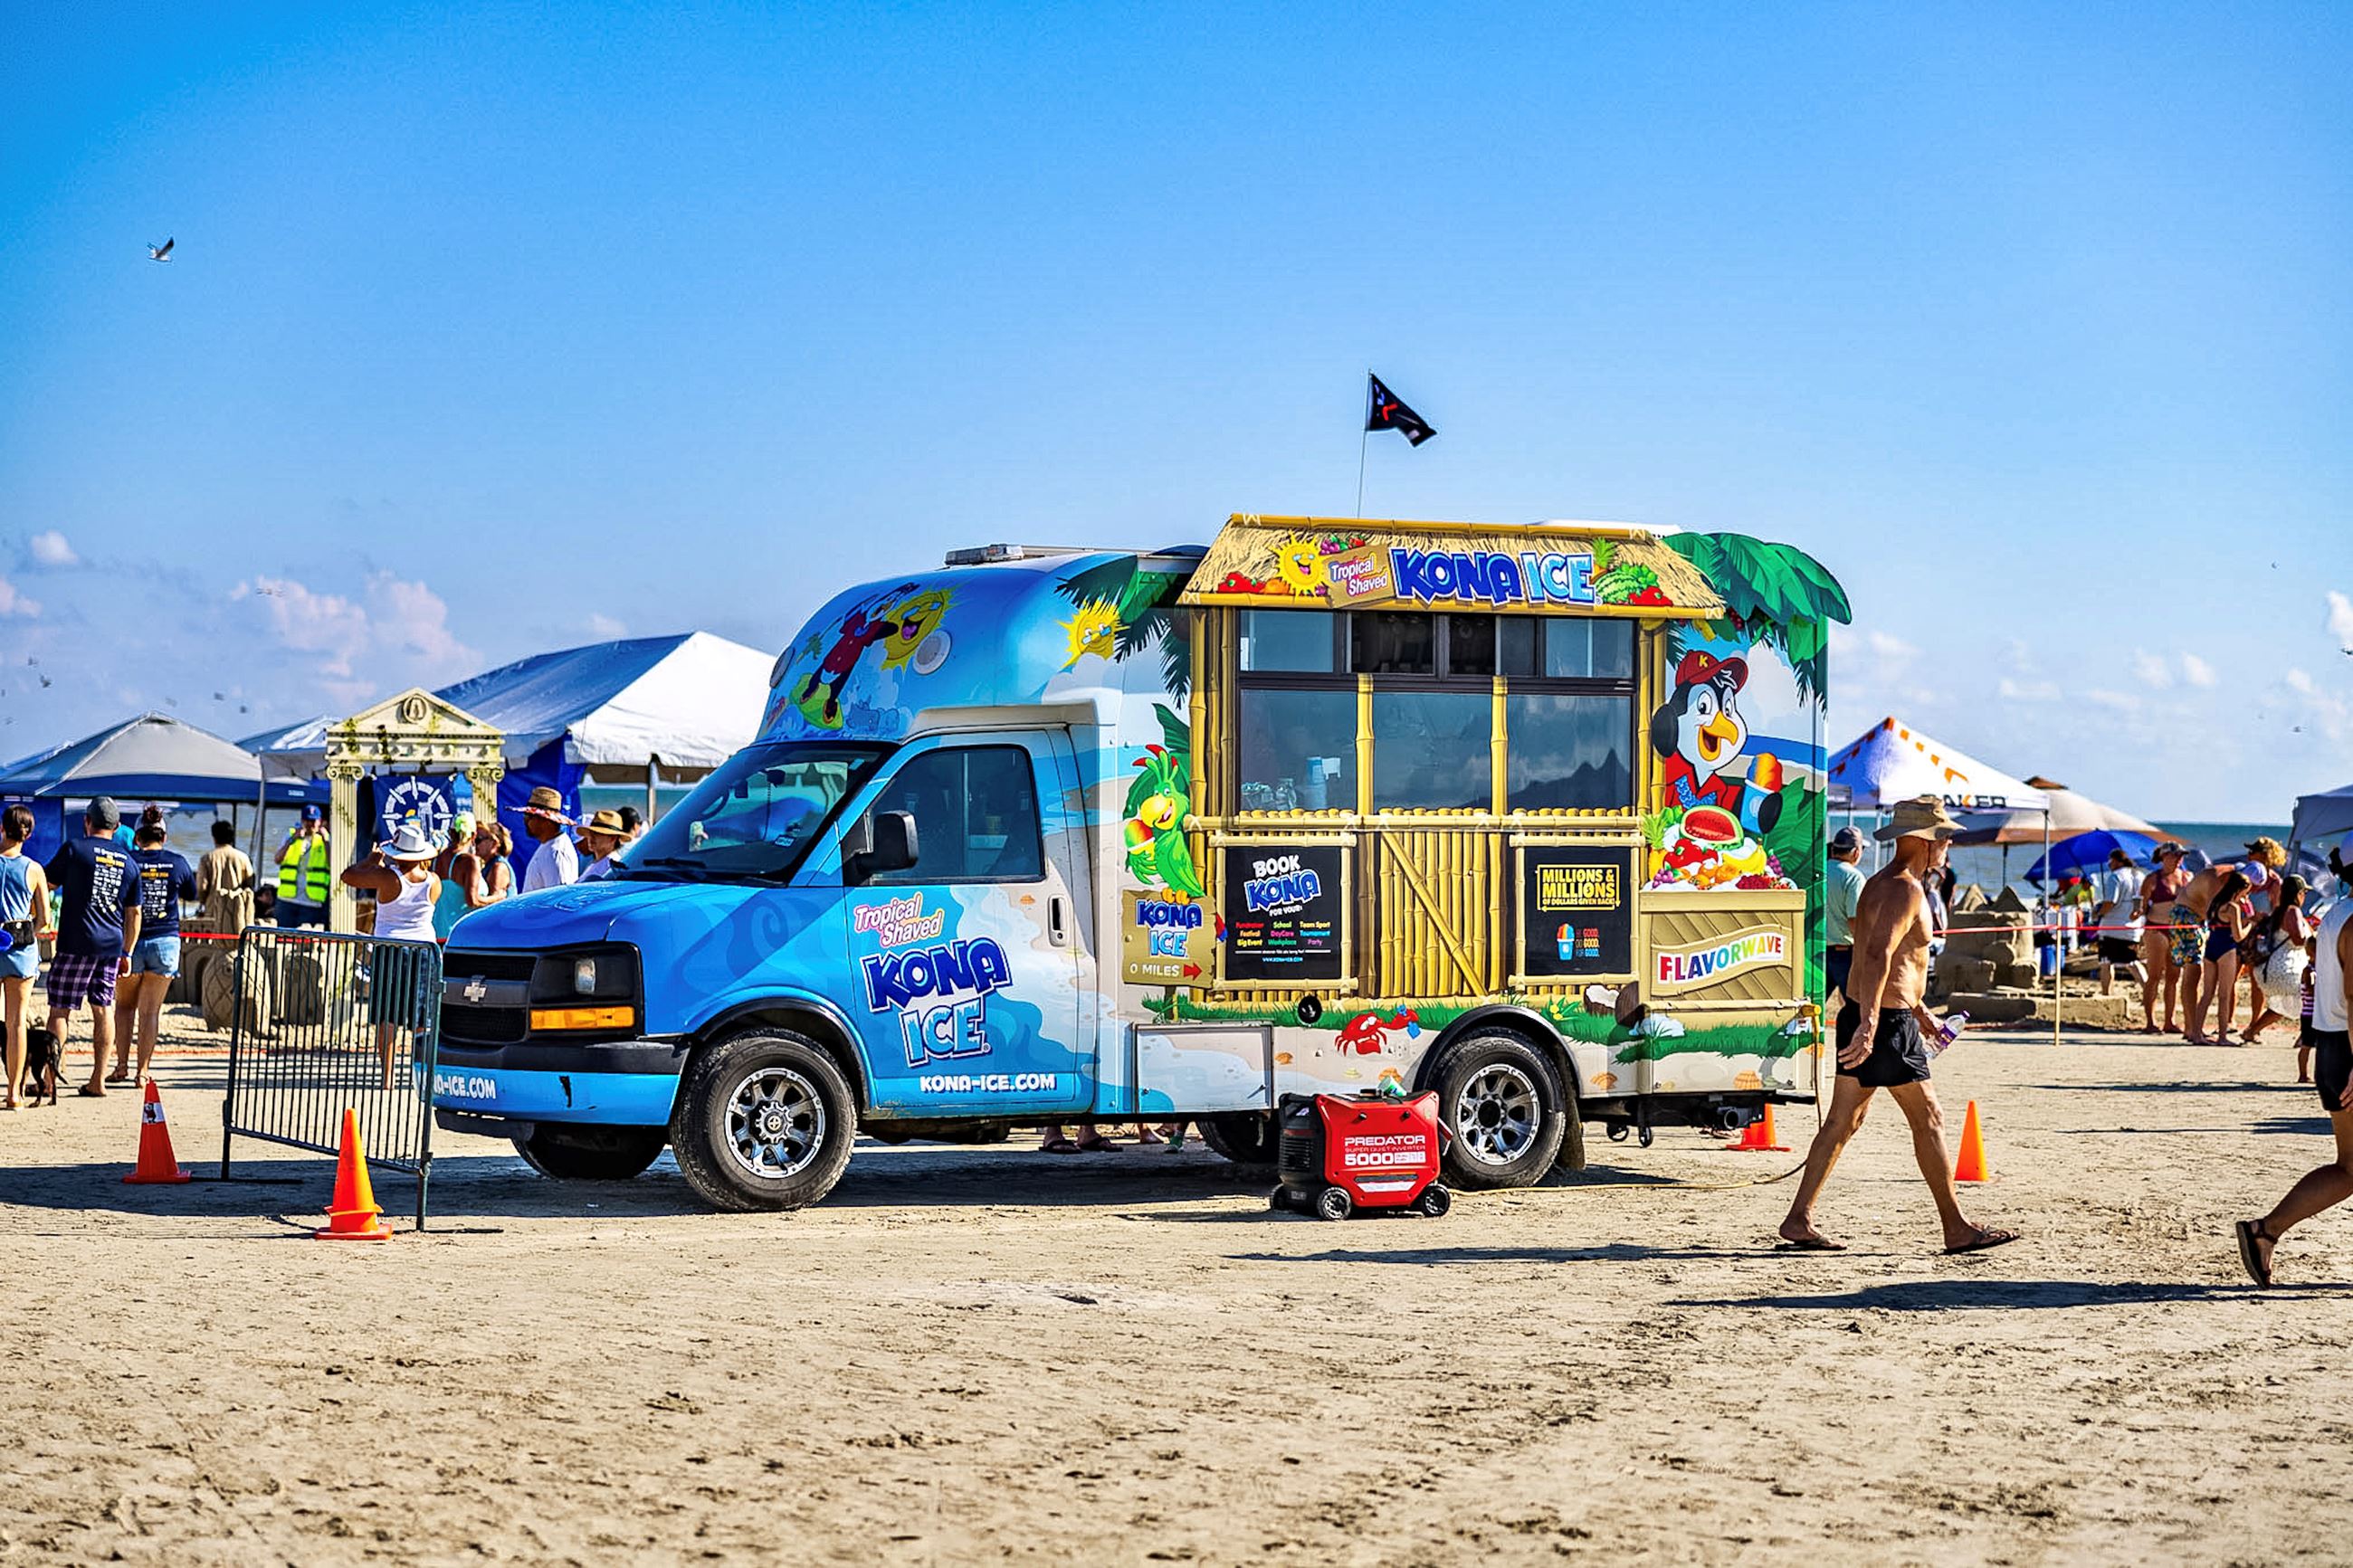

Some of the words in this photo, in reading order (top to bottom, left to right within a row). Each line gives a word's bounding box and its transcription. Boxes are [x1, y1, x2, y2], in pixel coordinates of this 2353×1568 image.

[1331, 555, 1375, 581] Tropical
[1391, 549, 1523, 605] KONA
[1521, 553, 1596, 604] ICE
[1348, 572, 1388, 595] Shaved
[1699, 654, 1708, 668] K
[1253, 854, 1300, 878] BOOK
[1542, 869, 1604, 882] MILLIONS
[1605, 869, 1615, 882] &
[1244, 870, 1321, 912] KONA
[1542, 882, 1615, 898] MILLIONS
[856, 893, 920, 931] Tropical
[1137, 900, 1202, 929] KONA
[1269, 908, 1282, 917] FOR
[881, 912, 942, 946] Shaved
[1150, 930, 1188, 957] ICE
[1237, 939, 1247, 947] Big
[1142, 964, 1180, 977] MILES
[1660, 936, 1782, 982] FLAVORWAVE
[862, 938, 1013, 1012] KONA
[901, 998, 985, 1067] ICE
[422, 1073, 497, 1099] A-ICE.COM
[919, 1073, 1056, 1093] KONA-ICE.COM
[1344, 1135, 1426, 1147] PREDATOR
[1345, 1153, 1395, 1166] 5000
